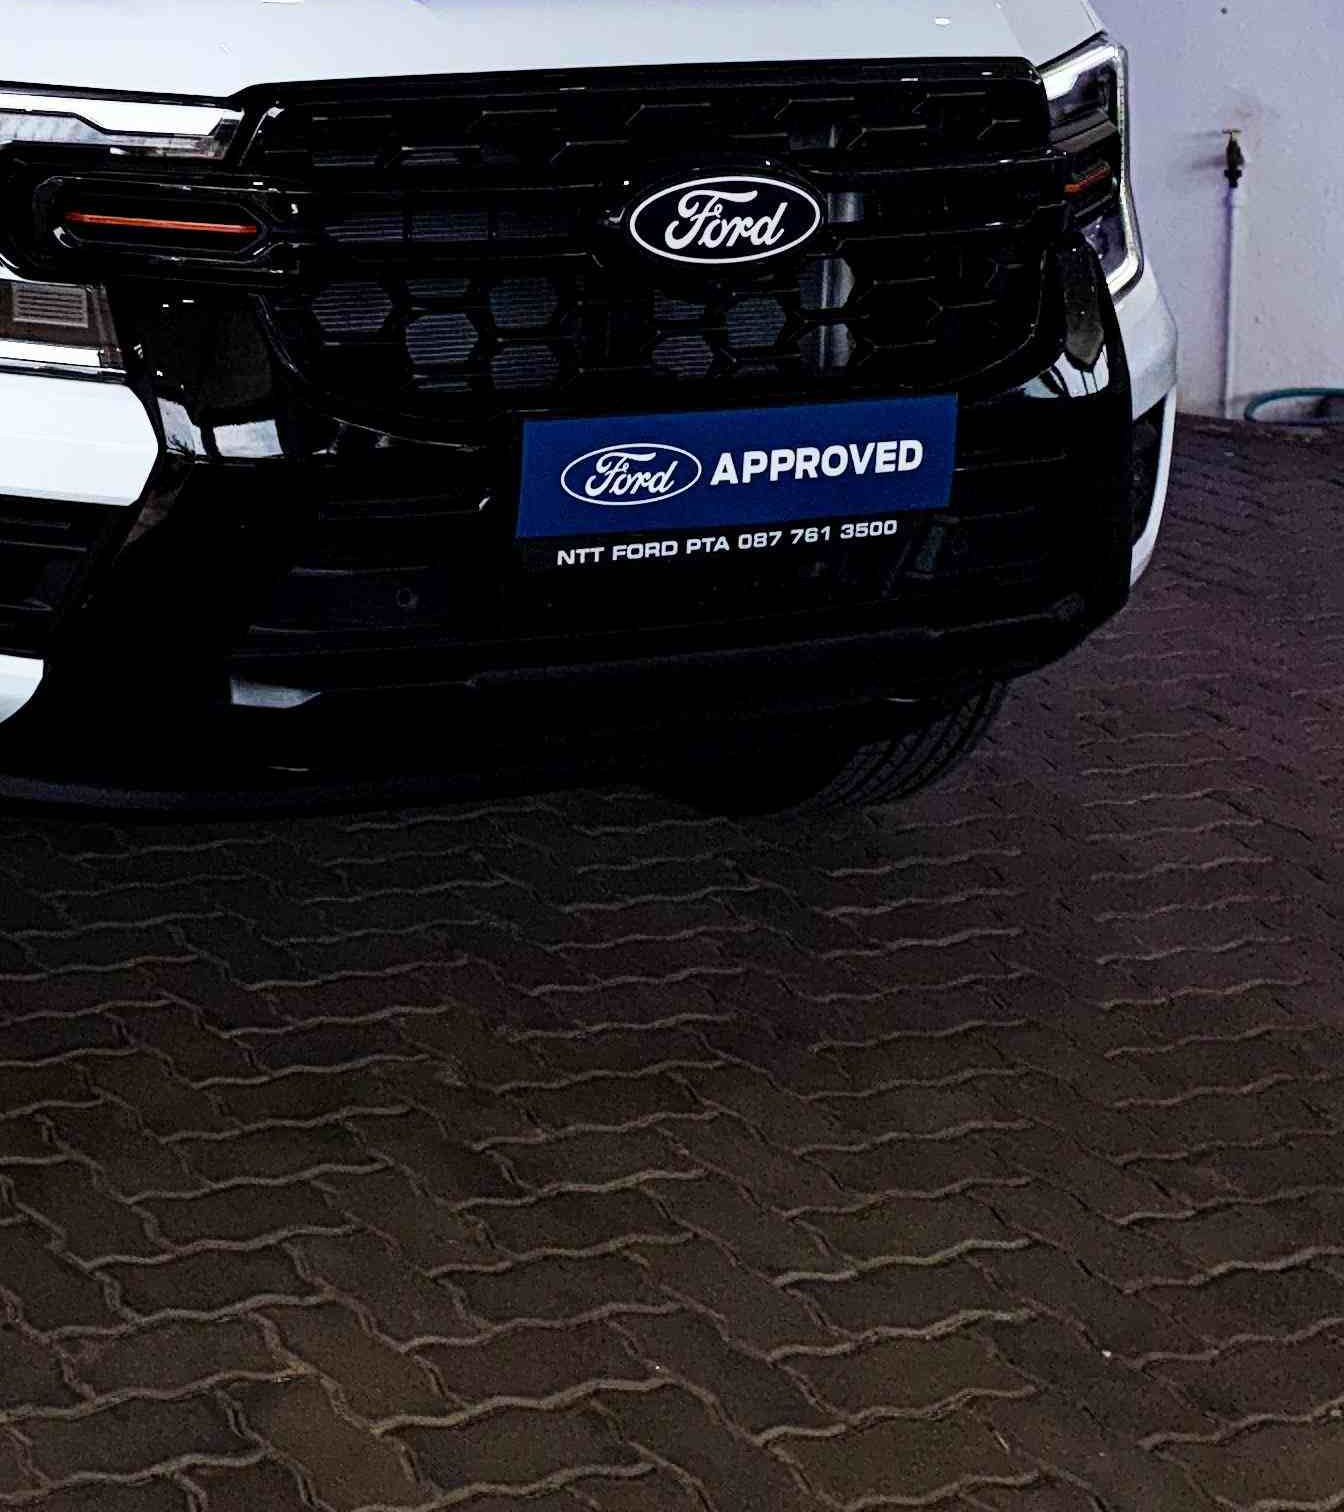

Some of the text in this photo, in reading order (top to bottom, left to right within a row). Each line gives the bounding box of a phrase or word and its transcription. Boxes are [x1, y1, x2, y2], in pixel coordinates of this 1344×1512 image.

[664, 189, 789, 250] Ford
[584, 439, 924, 497] Ford APPROVED
[556, 547, 606, 566] NTT
[611, 540, 679, 561] FORD
[685, 536, 731, 555] PTA
[737, 531, 783, 550] 087
[839, 520, 899, 539] 3500
